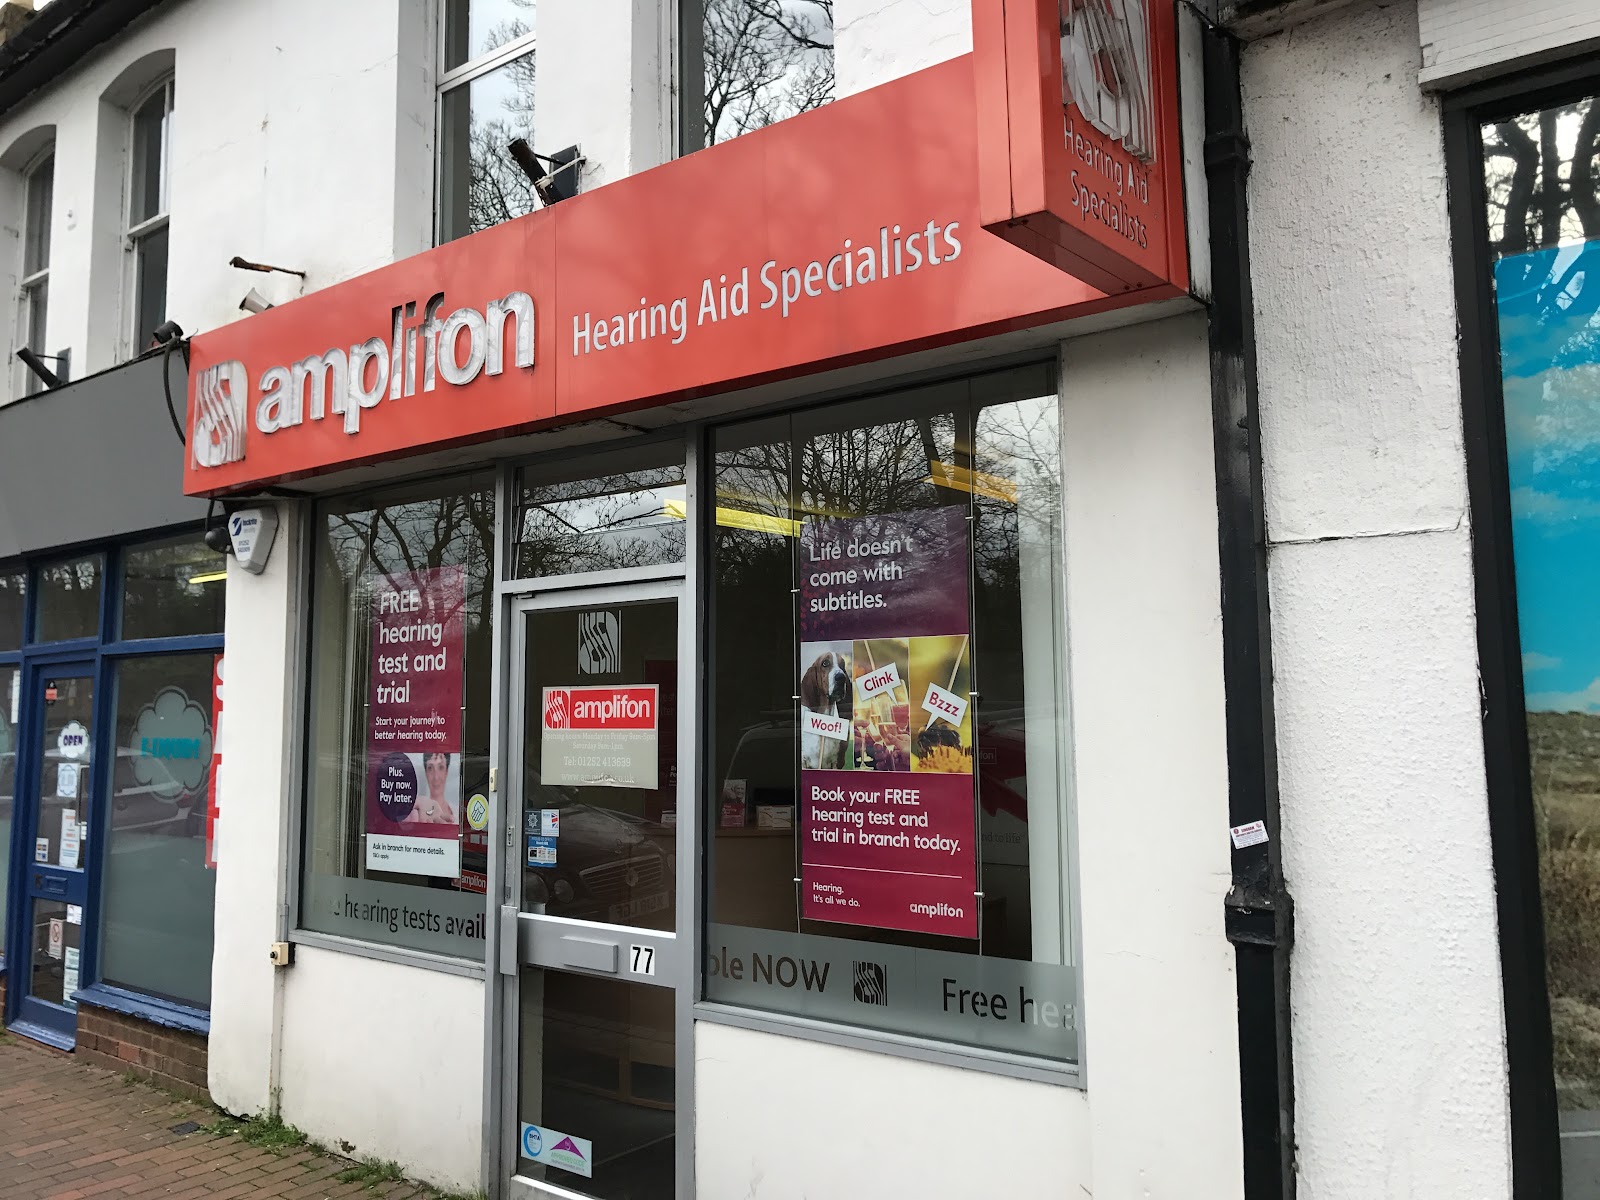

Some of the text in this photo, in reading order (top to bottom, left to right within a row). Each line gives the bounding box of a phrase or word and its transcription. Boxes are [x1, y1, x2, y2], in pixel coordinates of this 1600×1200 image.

[1063, 114, 1149, 205] Hearing Aid
[1071, 169, 1147, 249] Specialists
[572, 219, 961, 356] Hearing Aid Specialists
[255, 291, 535, 434] amplifon
[810, 536, 913, 561] Life doesn't
[810, 561, 902, 586] come with
[380, 590, 420, 614] FREE
[810, 590, 887, 612] subtitles.
[379, 619, 442, 647] hearing
[378, 647, 446, 674] test and
[376, 680, 410, 704] trial
[864, 671, 893, 692] Clink
[574, 694, 650, 724] amplifon
[928, 691, 960, 717] Bzzz
[375, 715, 445, 728] Start your journey to
[811, 717, 842, 734] Woof!
[63, 735, 83, 746] OPEN
[374, 730, 446, 742] better hearing today.
[388, 767, 404, 777] Plus.
[381, 779, 412, 791] Buy now.
[811, 786, 920, 806] Book your FREE
[380, 792, 412, 805] Pay later.
[811, 806, 929, 828] hearing test and
[387, 844, 404, 852] branch
[427, 846, 445, 855] details.
[811, 827, 961, 855] trial in branch today.
[462, 874, 486, 888] amplifon
[813, 882, 844, 895] Hearing.
[344, 893, 398, 933] hearing
[402, 906, 440, 933] tests
[813, 894, 860, 908] It's all we do.
[910, 902, 964, 918] amplifon
[632, 946, 653, 974] 77
[752, 952, 830, 993] NOW
[943, 978, 1008, 1020] Free
